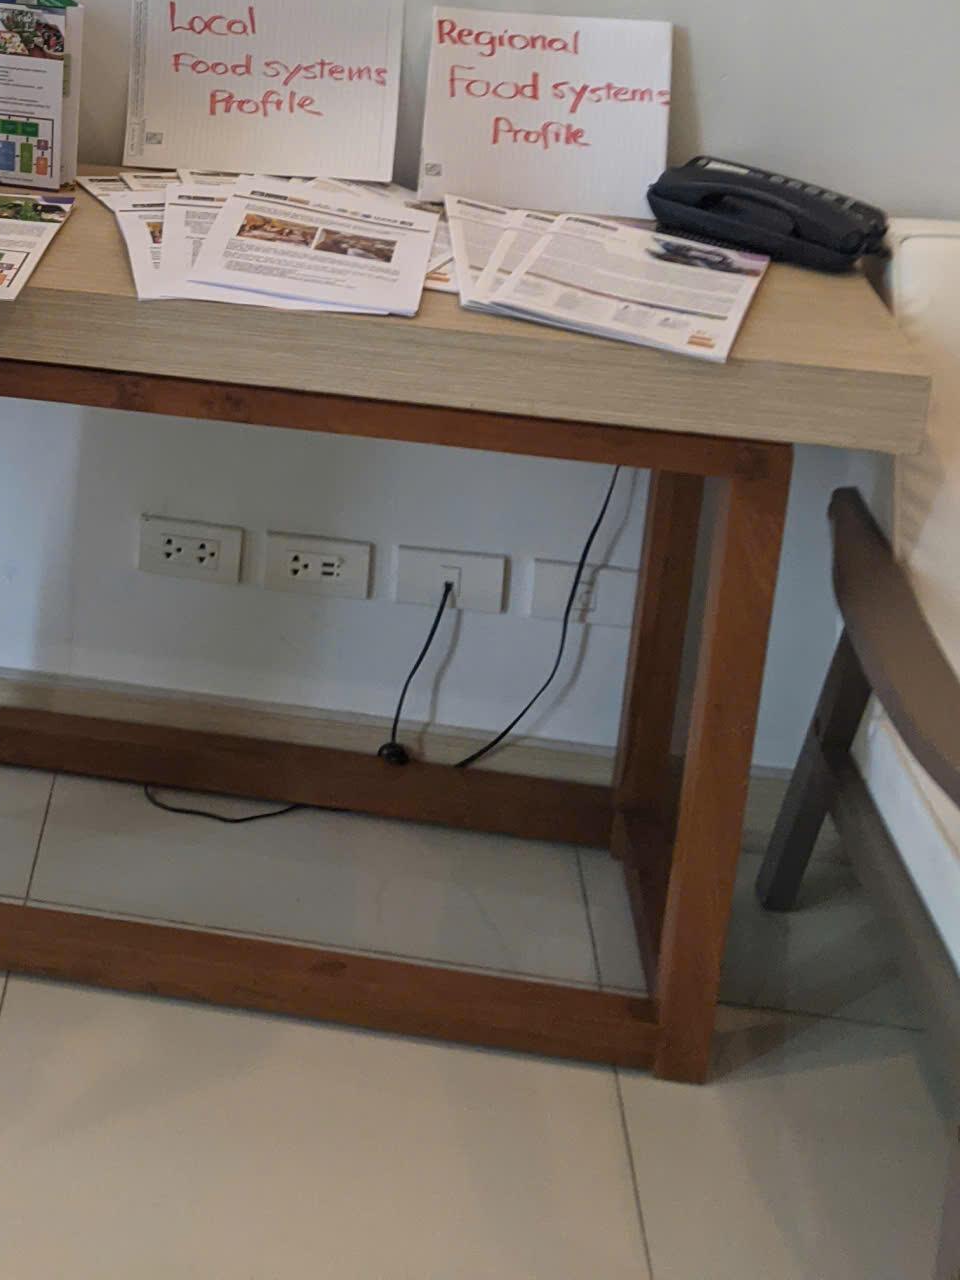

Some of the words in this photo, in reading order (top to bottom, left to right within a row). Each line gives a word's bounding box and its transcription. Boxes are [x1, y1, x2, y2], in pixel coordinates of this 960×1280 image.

[169, 1, 257, 36] Local
[436, 18, 581, 58] Regional
[172, 52, 253, 77] Food
[263, 59, 388, 87] systems
[448, 64, 540, 101] Food
[208, 89, 324, 118] Profile
[491, 116, 591, 150] Profile
